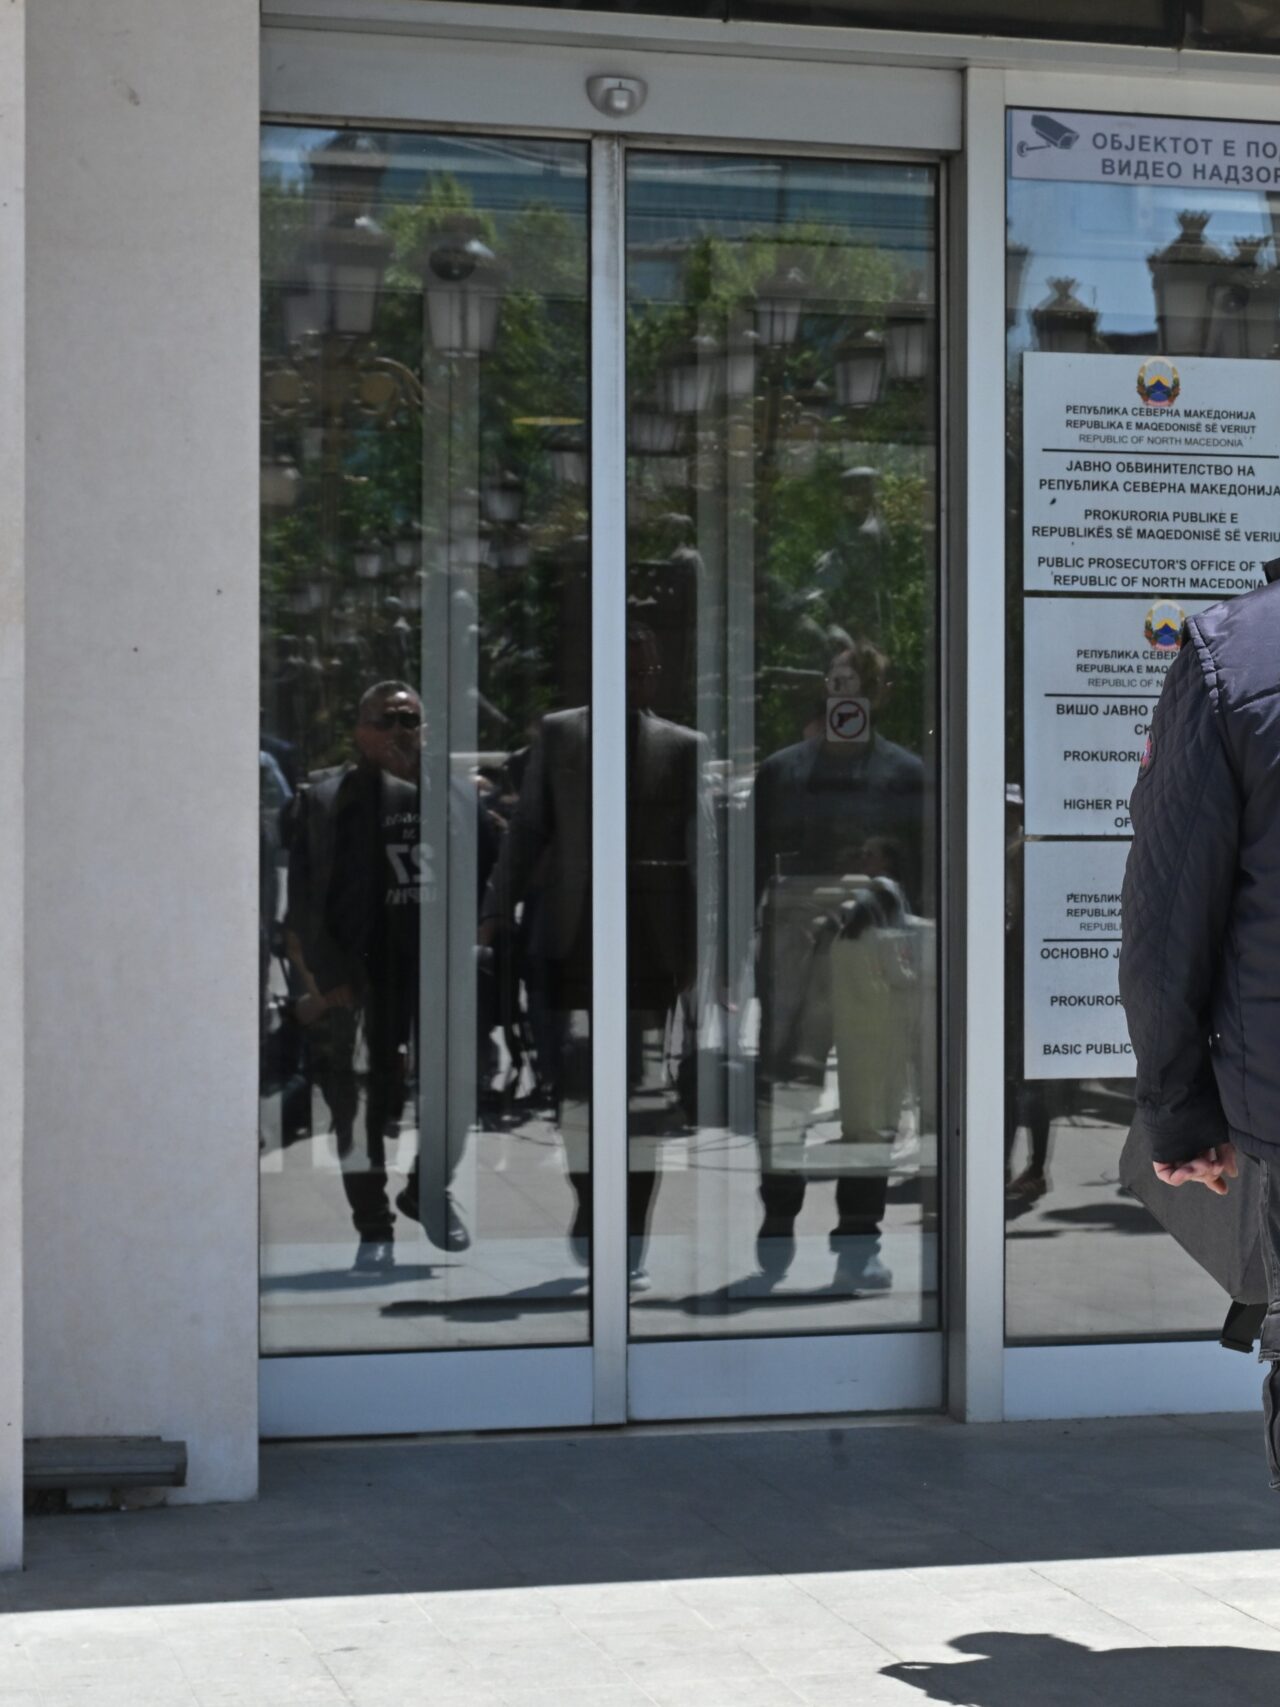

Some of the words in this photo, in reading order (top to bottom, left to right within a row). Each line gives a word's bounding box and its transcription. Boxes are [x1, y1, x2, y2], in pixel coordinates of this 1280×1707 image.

[1092, 133, 1212, 155] ОБЈЕКТОТ
[1224, 140, 1235, 156] Е
[1102, 158, 1182, 180] ВИДЕО
[1066, 405, 1128, 415] РЕПУБЛИКА
[1131, 407, 1180, 417] СЕВЕРНА
[1184, 409, 1255, 420] МАКЕДОНИЈА
[1066, 420, 1123, 429] REPUBLIKA
[1126, 422, 1132, 430] E
[1135, 421, 1201, 432] MAQEDONISË
[1205, 422, 1217, 433] SË
[1220, 425, 1256, 434] VERIUT
[1079, 434, 1128, 444] REPUBLIC
[1131, 436, 1144, 444] OF
[1147, 436, 1182, 445] NORTH
[1184, 438, 1243, 447] MACEDONIA
[1066, 461, 1111, 472] ЈАВНО
[1116, 462, 1233, 476] ОБВИНИТЕЛСТВО
[1238, 466, 1255, 476] НА
[1040, 479, 1119, 491] РЕПУБЛИКА
[1123, 481, 1186, 493] СЕВЕРНА
[1190, 483, 1280, 496] МАКЕДОНИЈА
[1085, 509, 1169, 521] PROKURORIA
[1173, 512, 1226, 523] PUBLIKE
[1231, 513, 1238, 523] E
[1032, 525, 1112, 538] REPUBLIKËS
[1117, 526, 1132, 539] SË
[1137, 528, 1220, 541] MAQEDONISË
[1225, 528, 1240, 541] SË
[1038, 557, 1084, 568] PUBLIC
[1088, 558, 1187, 570] PROSECUTOR'S
[1191, 560, 1235, 571] OFFICE
[1239, 561, 1255, 571] OF
[1054, 575, 1117, 586] REPUBLIC
[1121, 576, 1138, 587] OF
[1142, 577, 1185, 587] NORTH
[1077, 650, 1139, 659] РЕПУБЛИКА
[1142, 650, 1178, 660] СЕВЕР
[1076, 664, 1134, 673] REPUBLIKA
[1137, 665, 1142, 673] E
[1088, 678, 1137, 687] REPUBLIC
[1140, 679, 1153, 687] OF
[1057, 704, 1099, 715] ВИШО
[1103, 705, 1148, 716] ЈАВНО
[1064, 751, 1143, 762] PROKURORI
[1064, 799, 1112, 810] HIGHER
[1067, 893, 1122, 903] РЕПУБЛИК
[1040, 948, 1109, 959] ОСНОВНО
[1050, 995, 1122, 1007] PROKUROR
[1043, 1044, 1081, 1055] BASIC
[1086, 1043, 1132, 1055] PUBLIC
